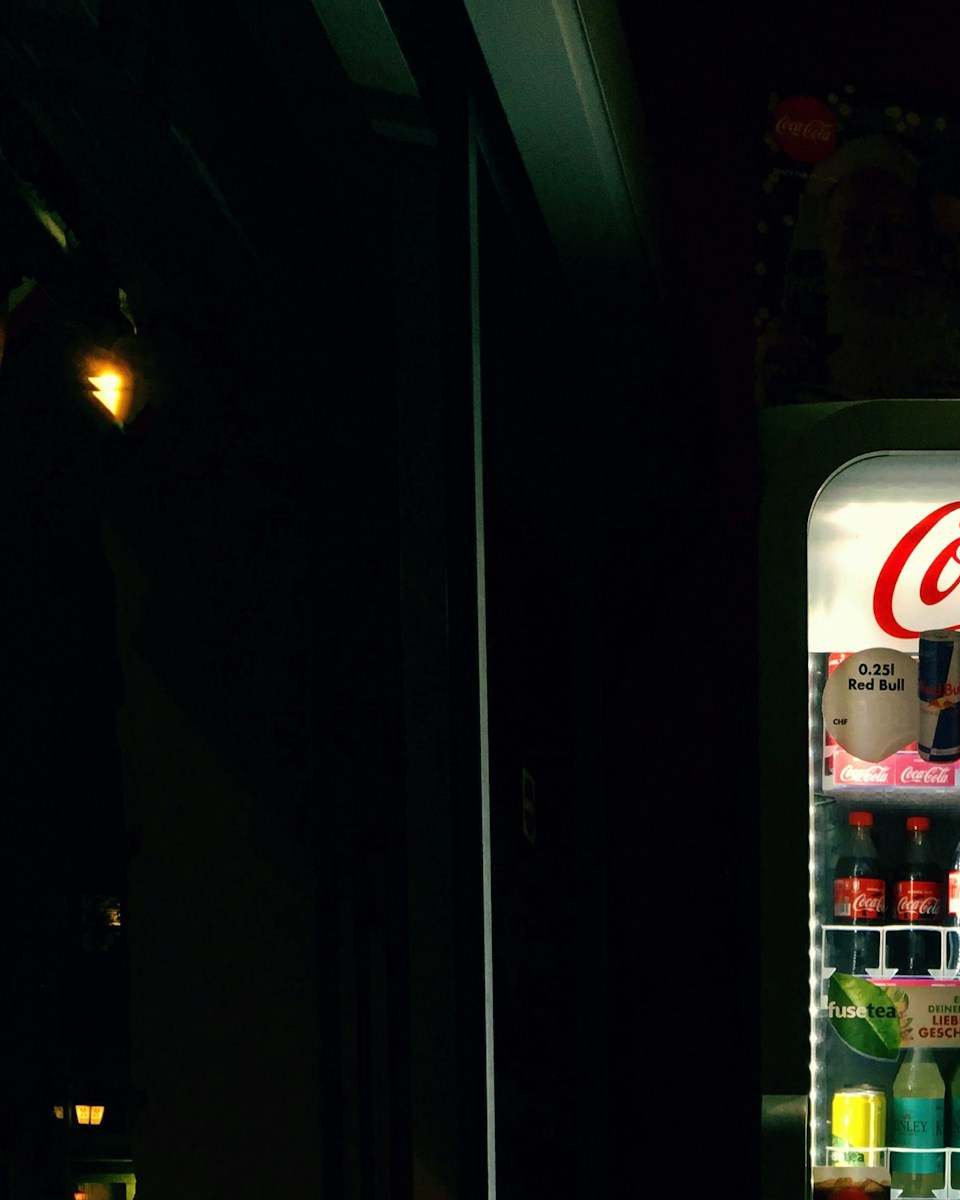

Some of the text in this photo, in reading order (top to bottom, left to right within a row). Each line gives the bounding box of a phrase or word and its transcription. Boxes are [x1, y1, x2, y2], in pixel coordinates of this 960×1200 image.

[848, 678, 905, 691] Red Bull
[833, 718, 848, 726] CHF
[900, 763, 950, 784] Coca-Cola
